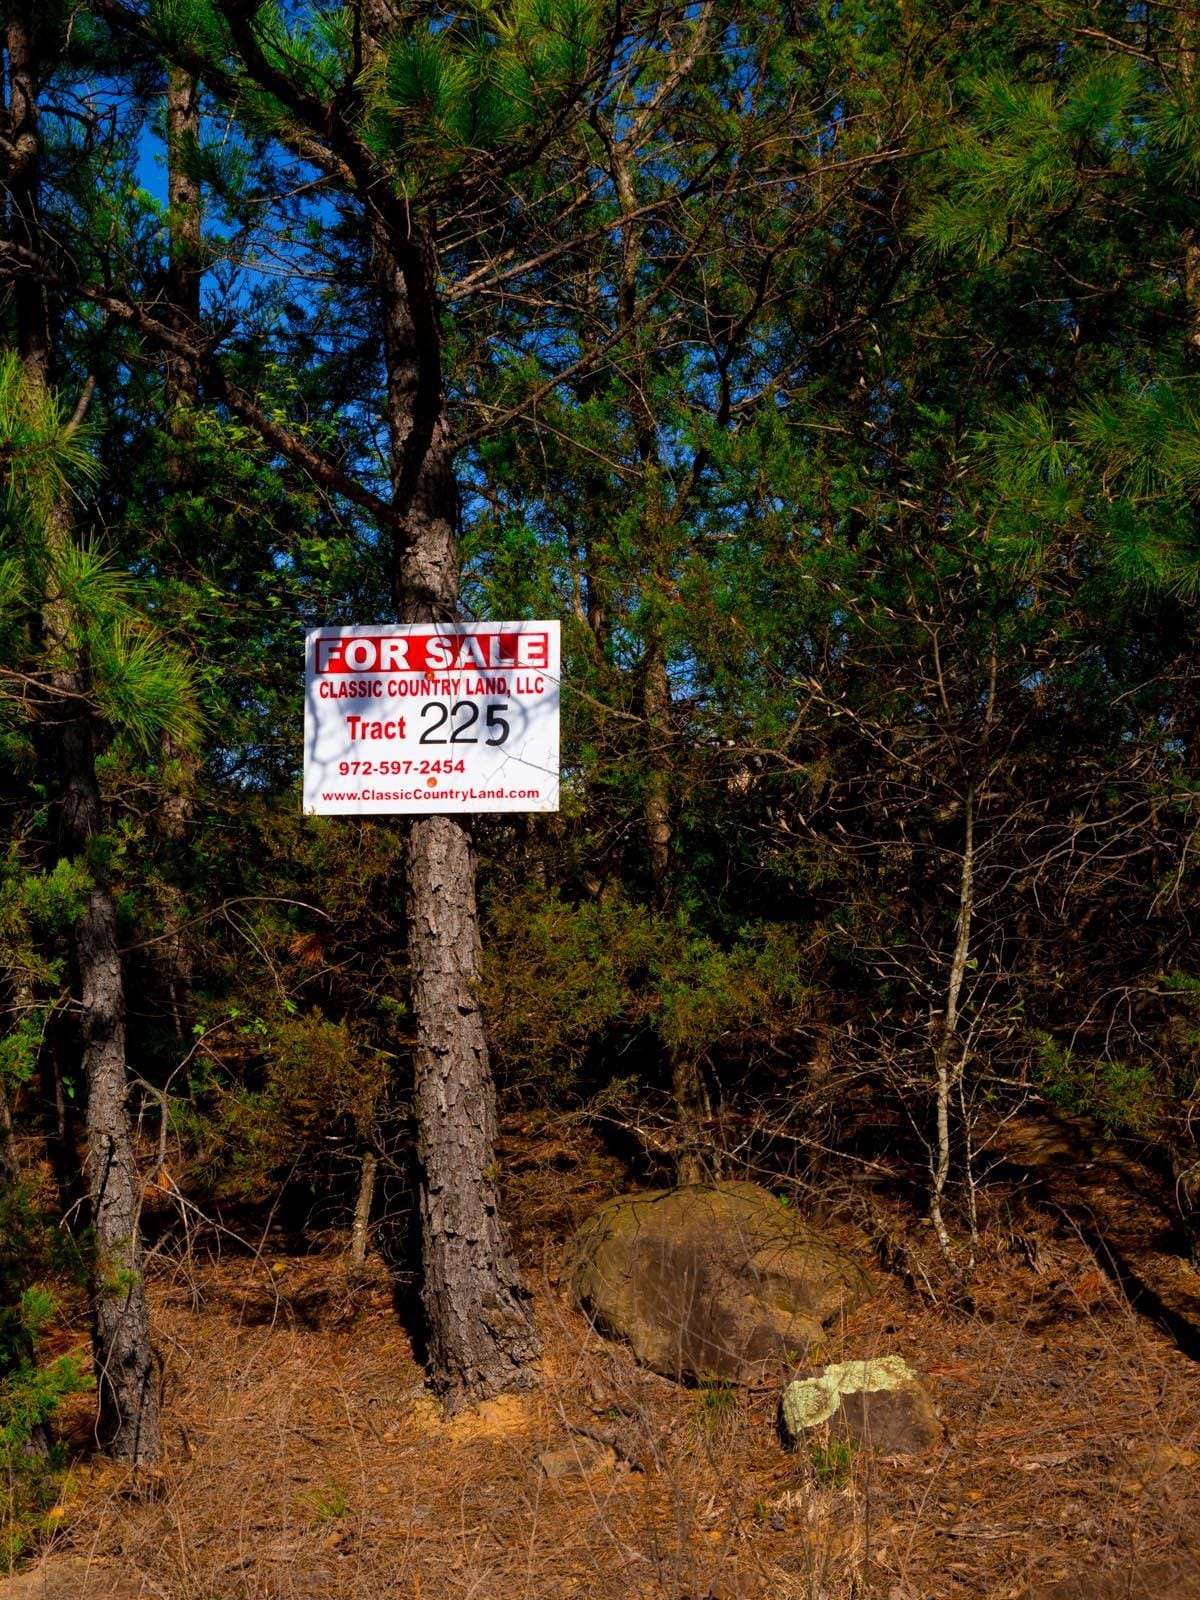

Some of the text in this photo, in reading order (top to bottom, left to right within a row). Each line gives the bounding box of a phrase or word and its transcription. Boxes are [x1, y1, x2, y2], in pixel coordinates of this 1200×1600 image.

[318, 635, 546, 672] FOR SALE
[319, 677, 545, 699] CLASSIC COUNTRY LAND, LLC
[346, 701, 510, 746] Tract 225
[338, 760, 466, 776] 972-597-2454
[322, 787, 540, 802] www.ClassicCountryLand.com
